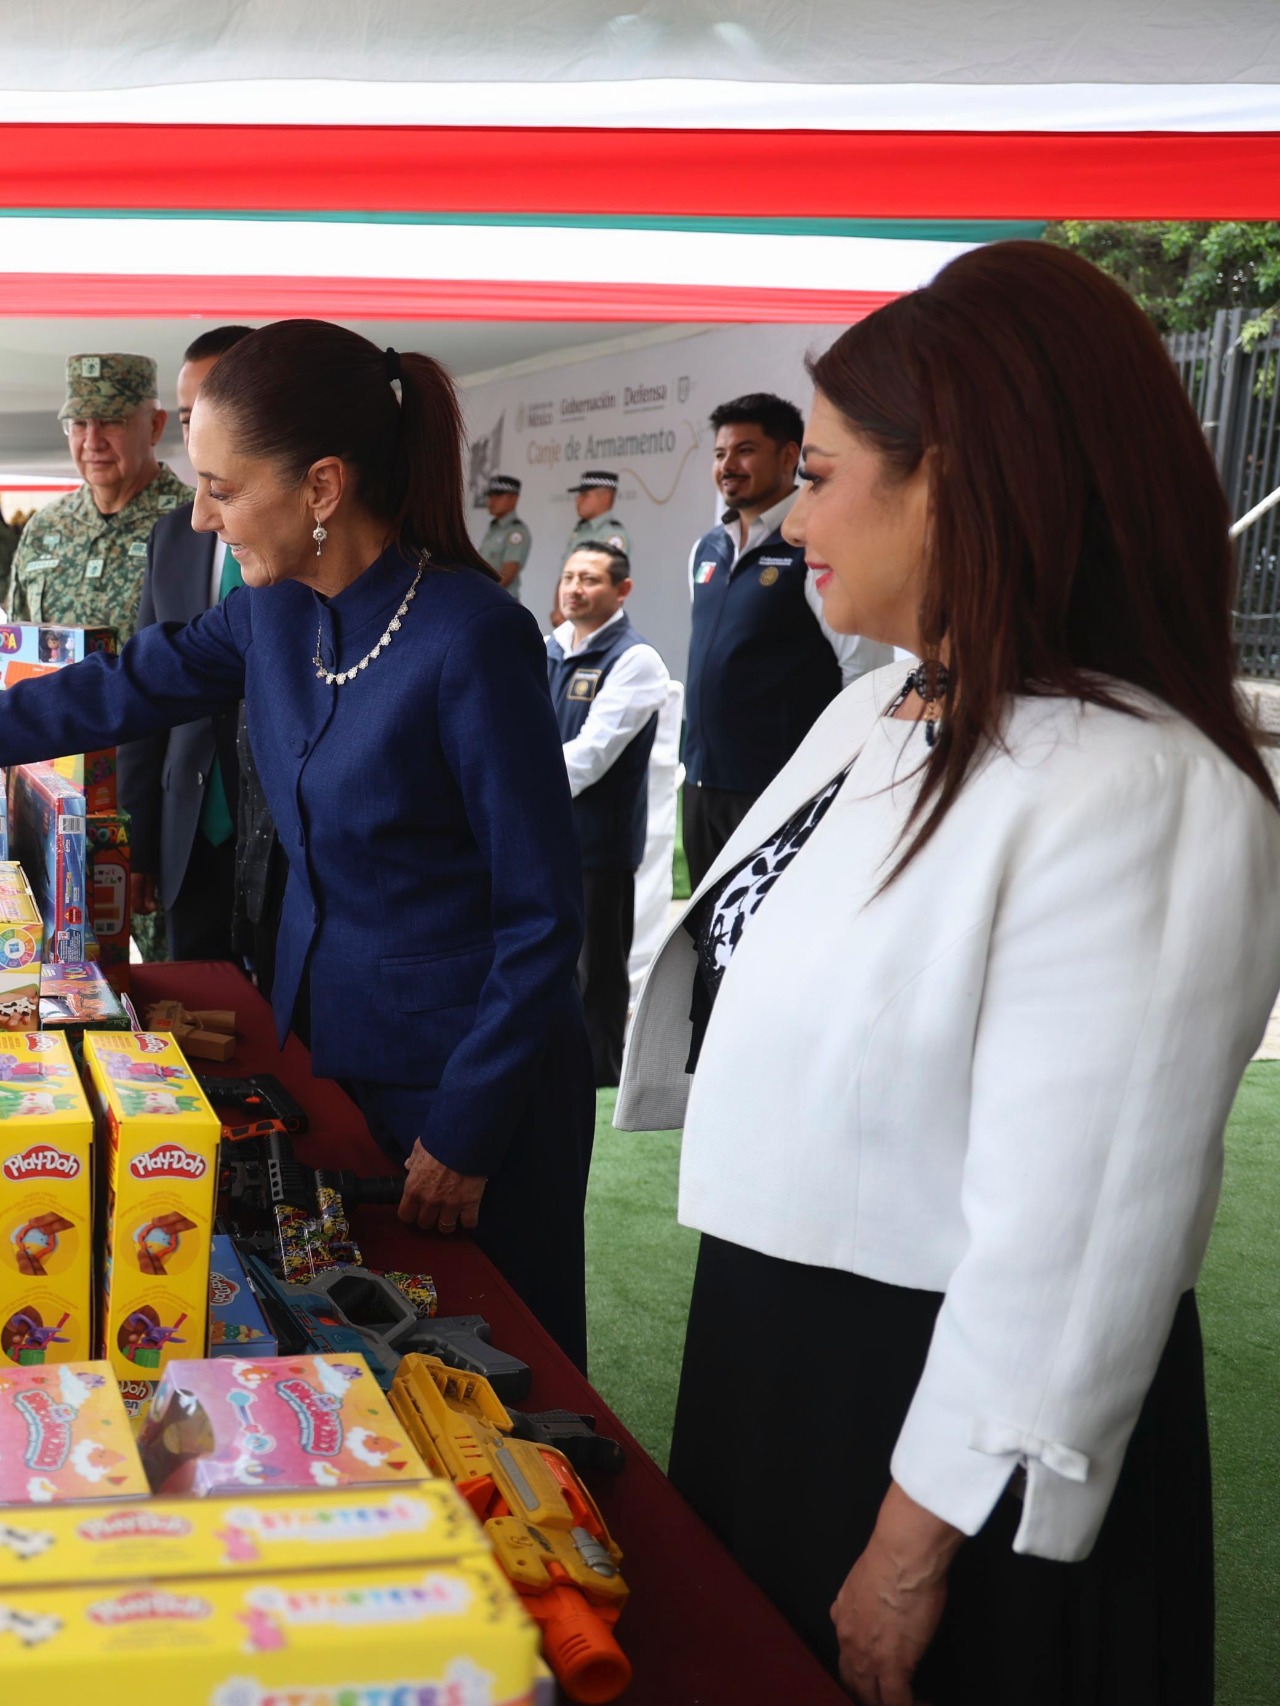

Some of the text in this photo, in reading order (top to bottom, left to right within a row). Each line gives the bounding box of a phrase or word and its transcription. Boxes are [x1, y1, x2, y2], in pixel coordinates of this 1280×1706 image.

[560, 391, 616, 417] Gobernación
[624, 383, 668, 407] Defensa
[527, 429, 677, 469] Canje de Armamento
[87, 826, 128, 844] DORA
[3, 1148, 81, 1178] Play-Doh
[130, 1148, 206, 1179] Play-Doh
